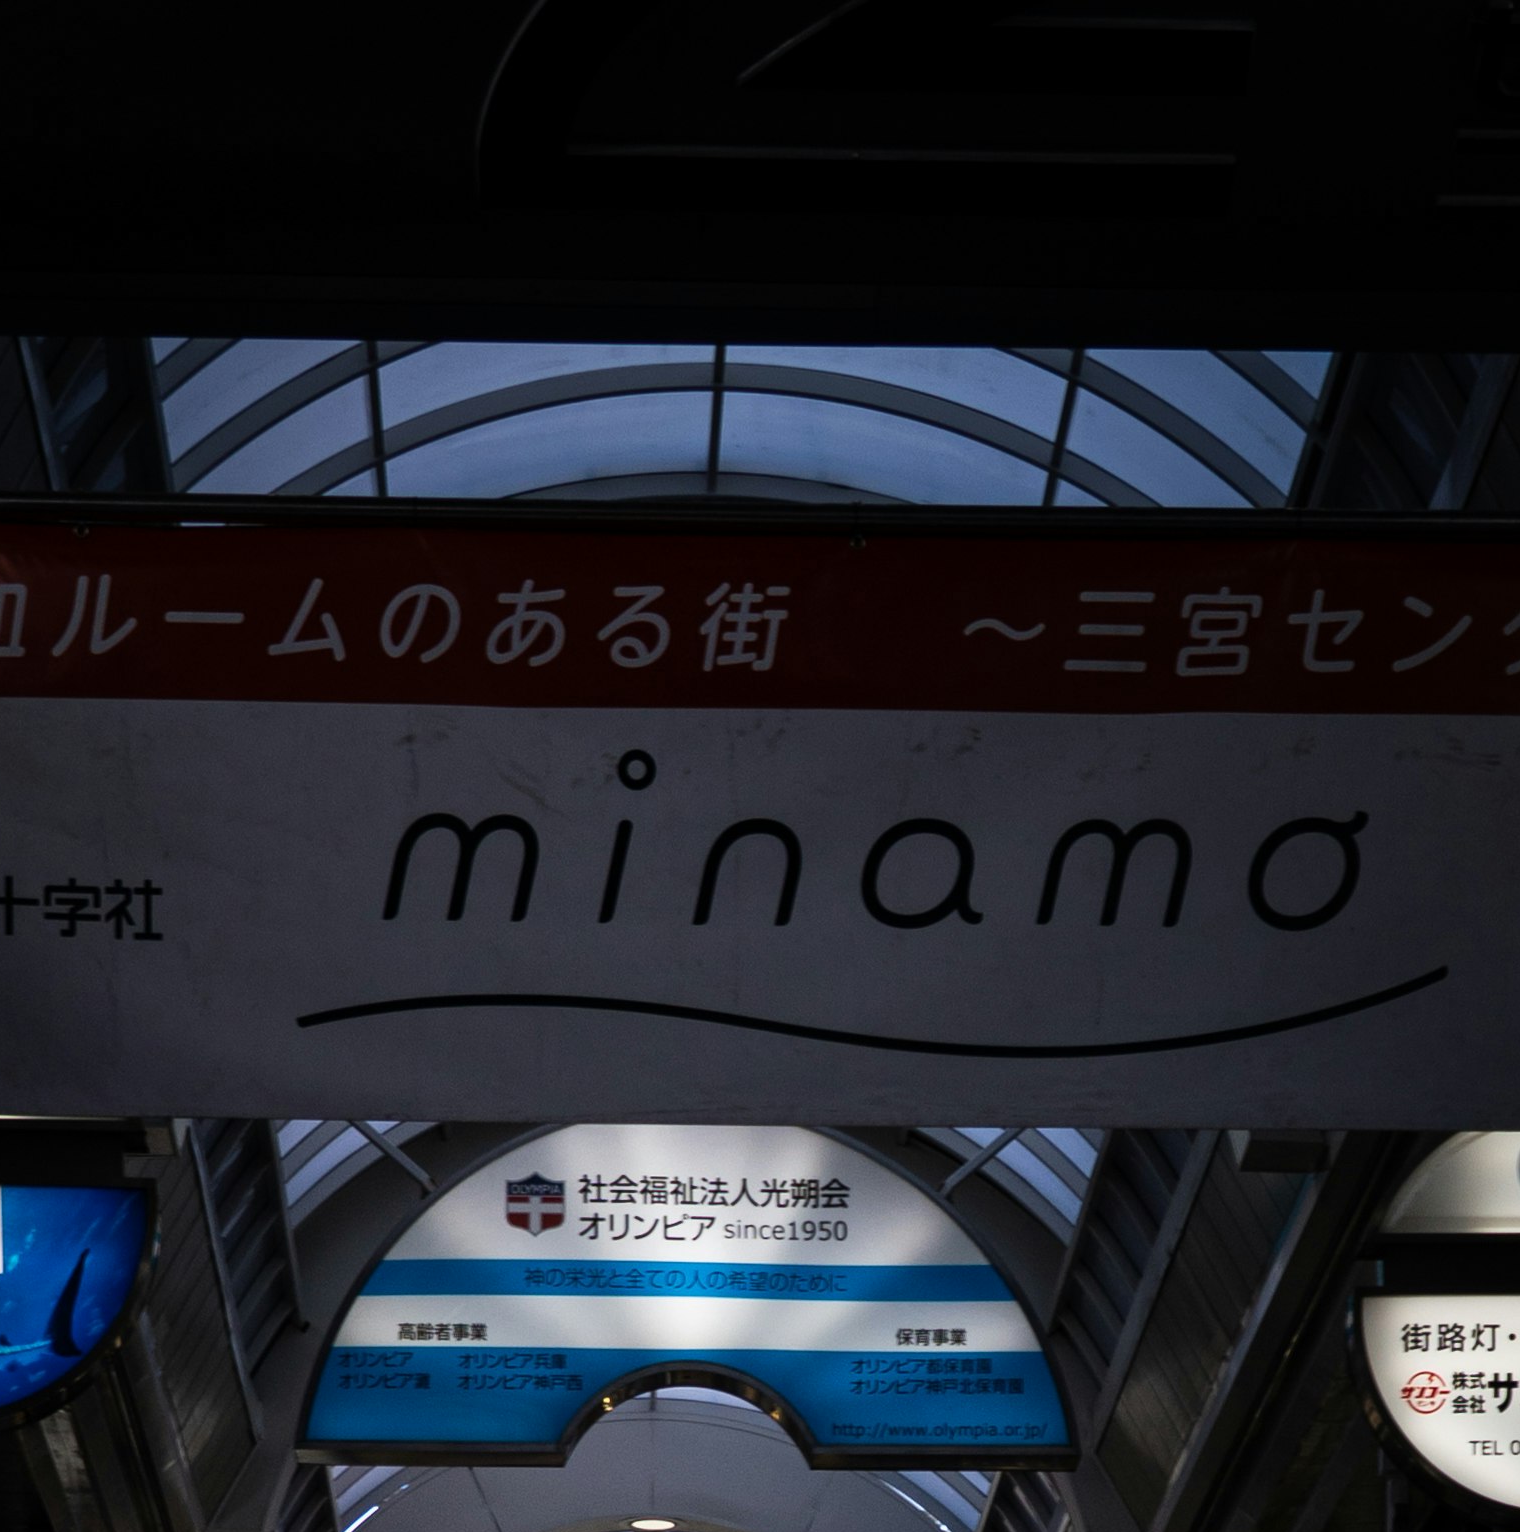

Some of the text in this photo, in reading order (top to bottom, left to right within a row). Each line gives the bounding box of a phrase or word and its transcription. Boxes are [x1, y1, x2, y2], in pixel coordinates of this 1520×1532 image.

[382, 748, 1369, 930] minamo
[578, 1174, 851, 1211] 社会福祉法人光朔会
[578, 1213, 849, 1243] オリンピア since1950
[523, 1267, 848, 1293] 神の栄光と全ての人の希望のために
[397, 1322, 488, 1342] 高齢者事業
[896, 1328, 968, 1346] 保育事業
[1469, 1440, 1504, 1457] TEL
